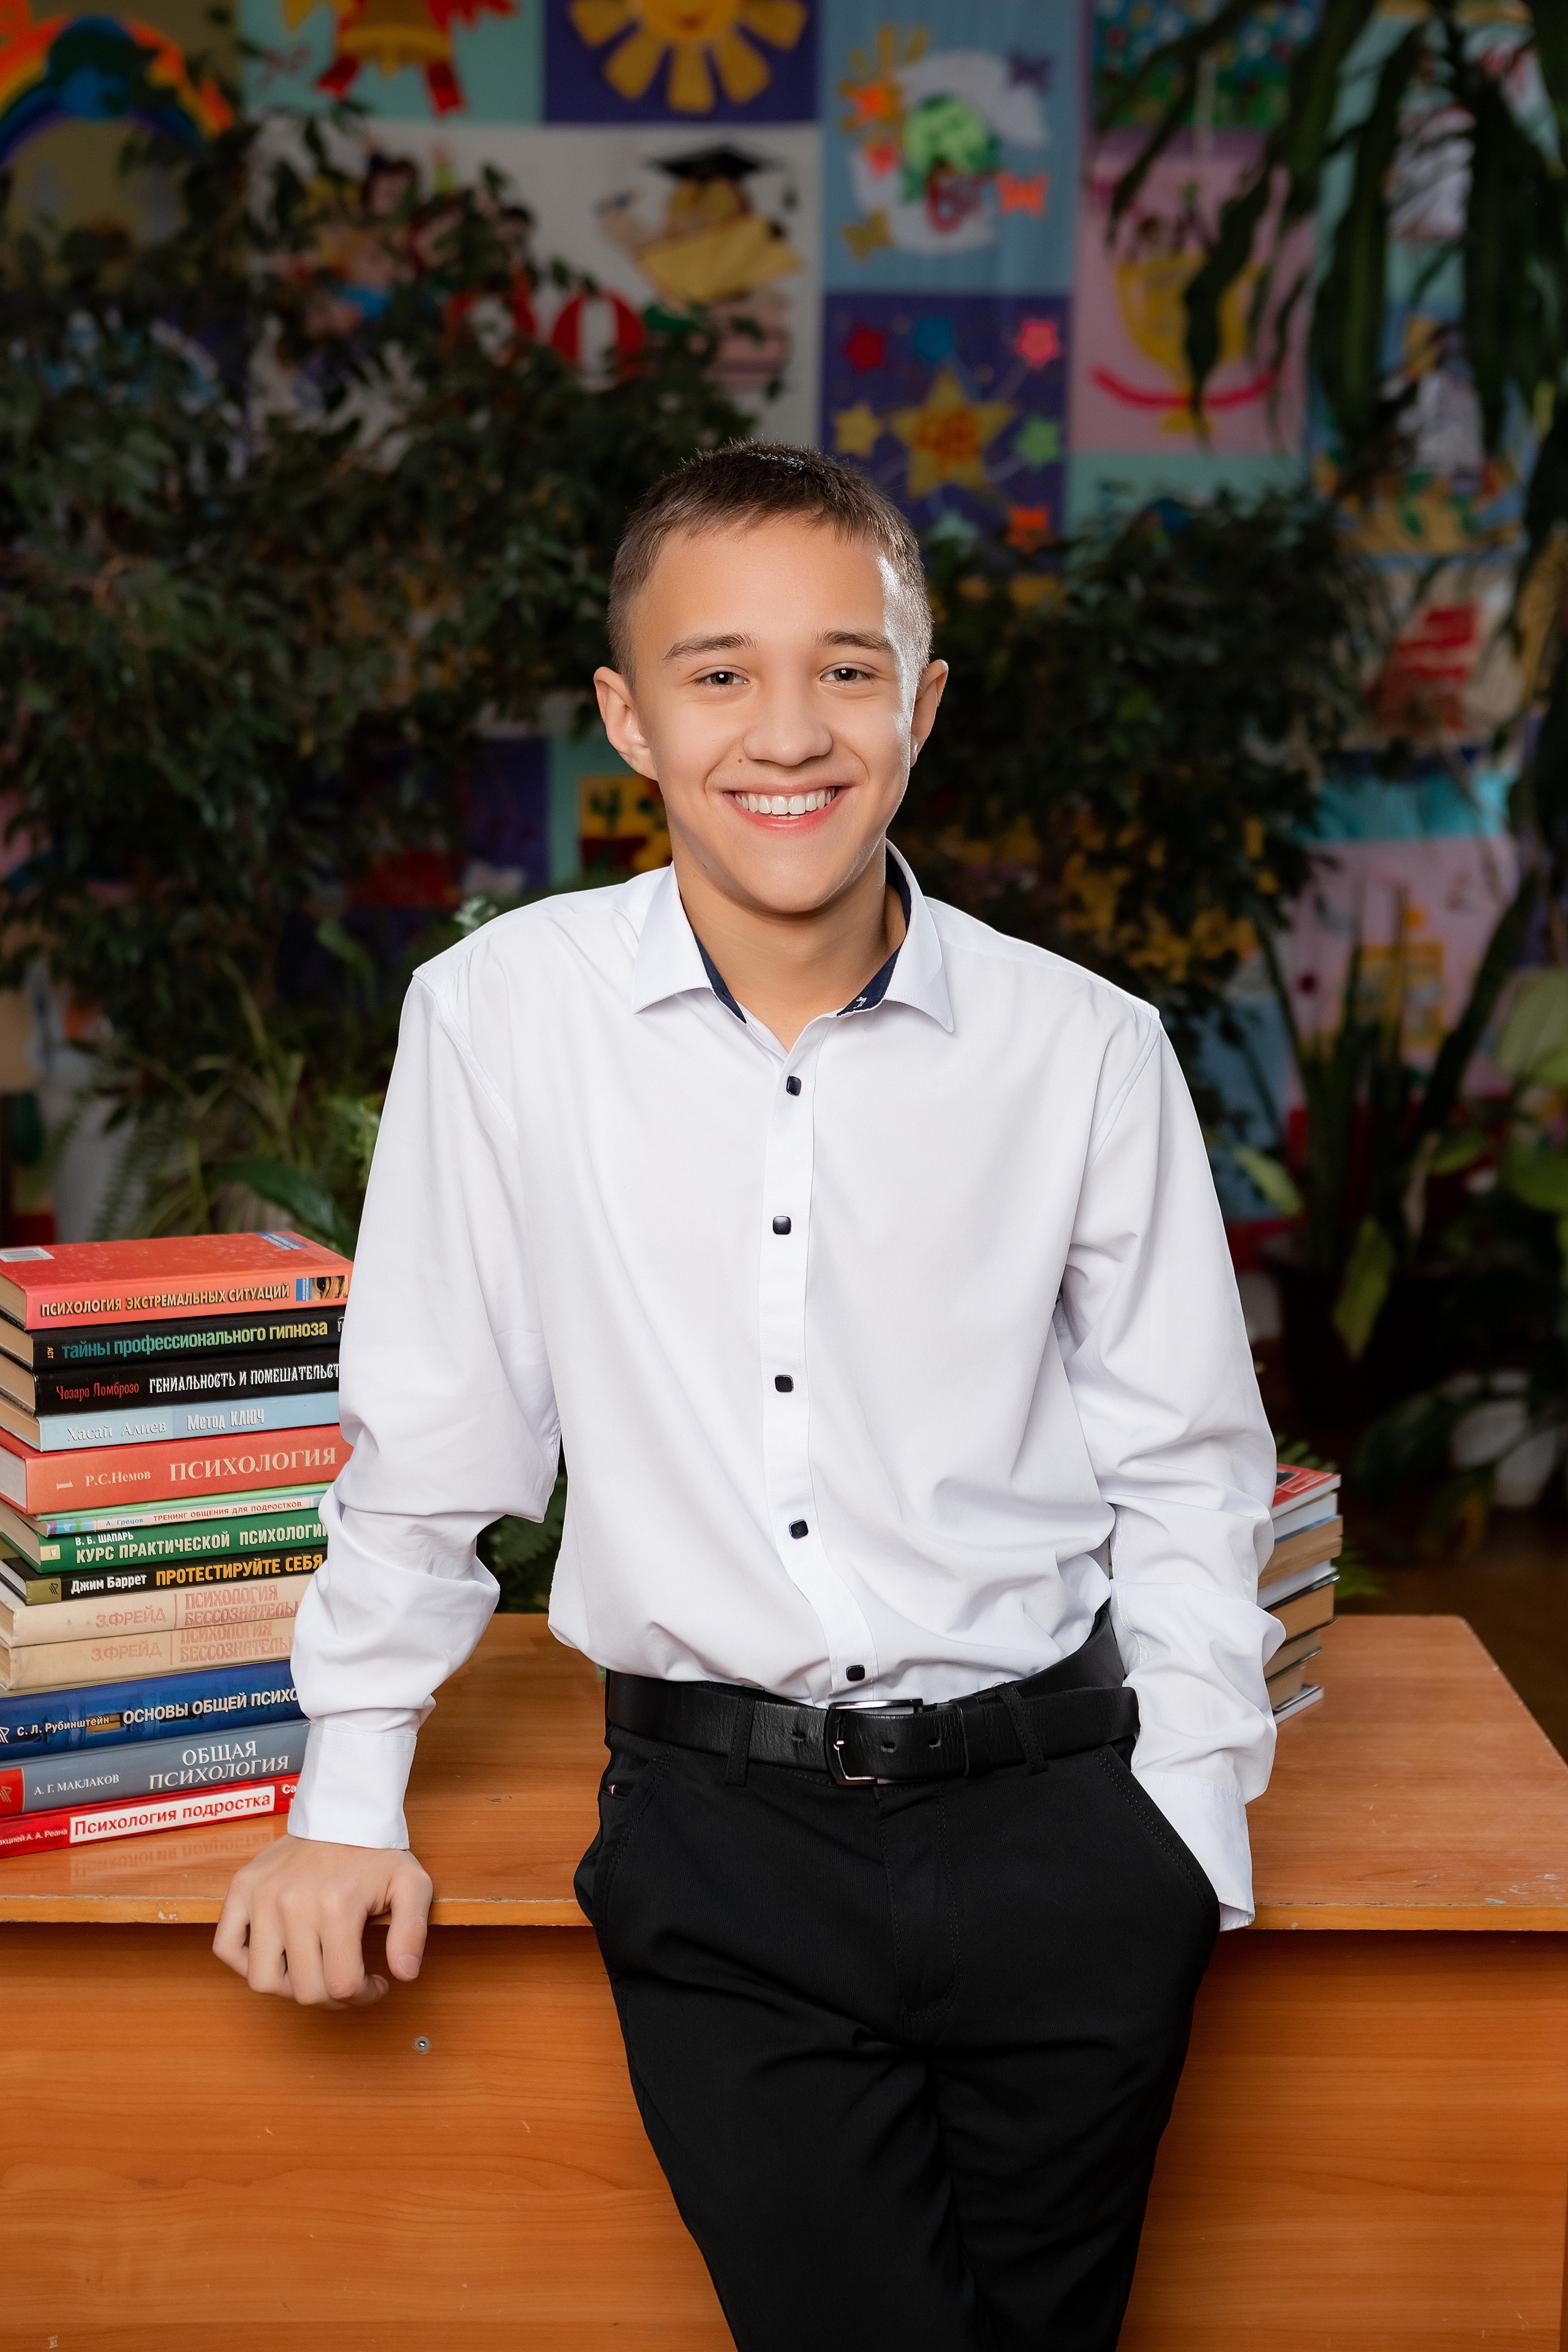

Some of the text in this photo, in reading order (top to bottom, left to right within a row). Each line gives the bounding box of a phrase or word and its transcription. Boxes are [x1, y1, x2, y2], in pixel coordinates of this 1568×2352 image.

[42, 1298, 122, 1317] ПСИХОЛОГИЯ
[126, 1290, 226, 1310] ЭКСТРЕМАЛЬНЫХ
[228, 1283, 290, 1302] СИТУАЦИЙ
[62, 1340, 110, 1359] тайны
[114, 1327, 266, 1357] профессионального
[270, 1321, 328, 1340] гипноза
[56, 1382, 140, 1402] Чезаре Ломброзо
[149, 1371, 236, 1393] ГЕНИАЛЬНОСТЬ
[239, 1370, 247, 1386] И
[67, 1422, 167, 1441] Хасай Алиев
[187, 1409, 265, 1431] Метод КЛЮЧ
[170, 1447, 336, 1481] ПСИХОЛОГИЯ
[86, 1471, 151, 1487] Р.С.Немов
[117, 1518, 144, 1526] Грецов
[154, 1513, 187, 1521] ТРЕНИНГ
[190, 1509, 229, 1518] ОБЩЕНИЯ
[251, 1501, 302, 1512] ПОДРОСТКОВ
[75, 1531, 134, 1546] В. Б. ШАПАРЬ
[77, 1546, 115, 1564] КУРС
[119, 1531, 230, 1559] ПРАКТИЧЕСКОЙ
[156, 1554, 323, 1586] ПРОТЕСТИРУЙТЕ СЕБЯ
[70, 1574, 147, 1594] Джим Баррет
[184, 1585, 279, 1610] ПСИХОЛОГИЯ
[96, 1605, 167, 1629] З.ФРЕЙД
[180, 1621, 274, 1645] ПСИХОЛОГИЯ
[123, 1703, 189, 1725] ОСНОВЫ
[192, 1692, 247, 1714] ОБЩЕЙ
[17, 1716, 110, 1736] С. Л. Рубинштейн
[183, 1740, 257, 1766] ОБЩАЯ
[149, 1755, 290, 1790] ПСИХОЛОГИЯ
[34, 1774, 119, 1796] А. Г. МАКЛАКОВ
[75, 1810, 177, 1836] Психология
[183, 1794, 271, 1819] подростка
[44, 1828, 68, 1838] Реана
